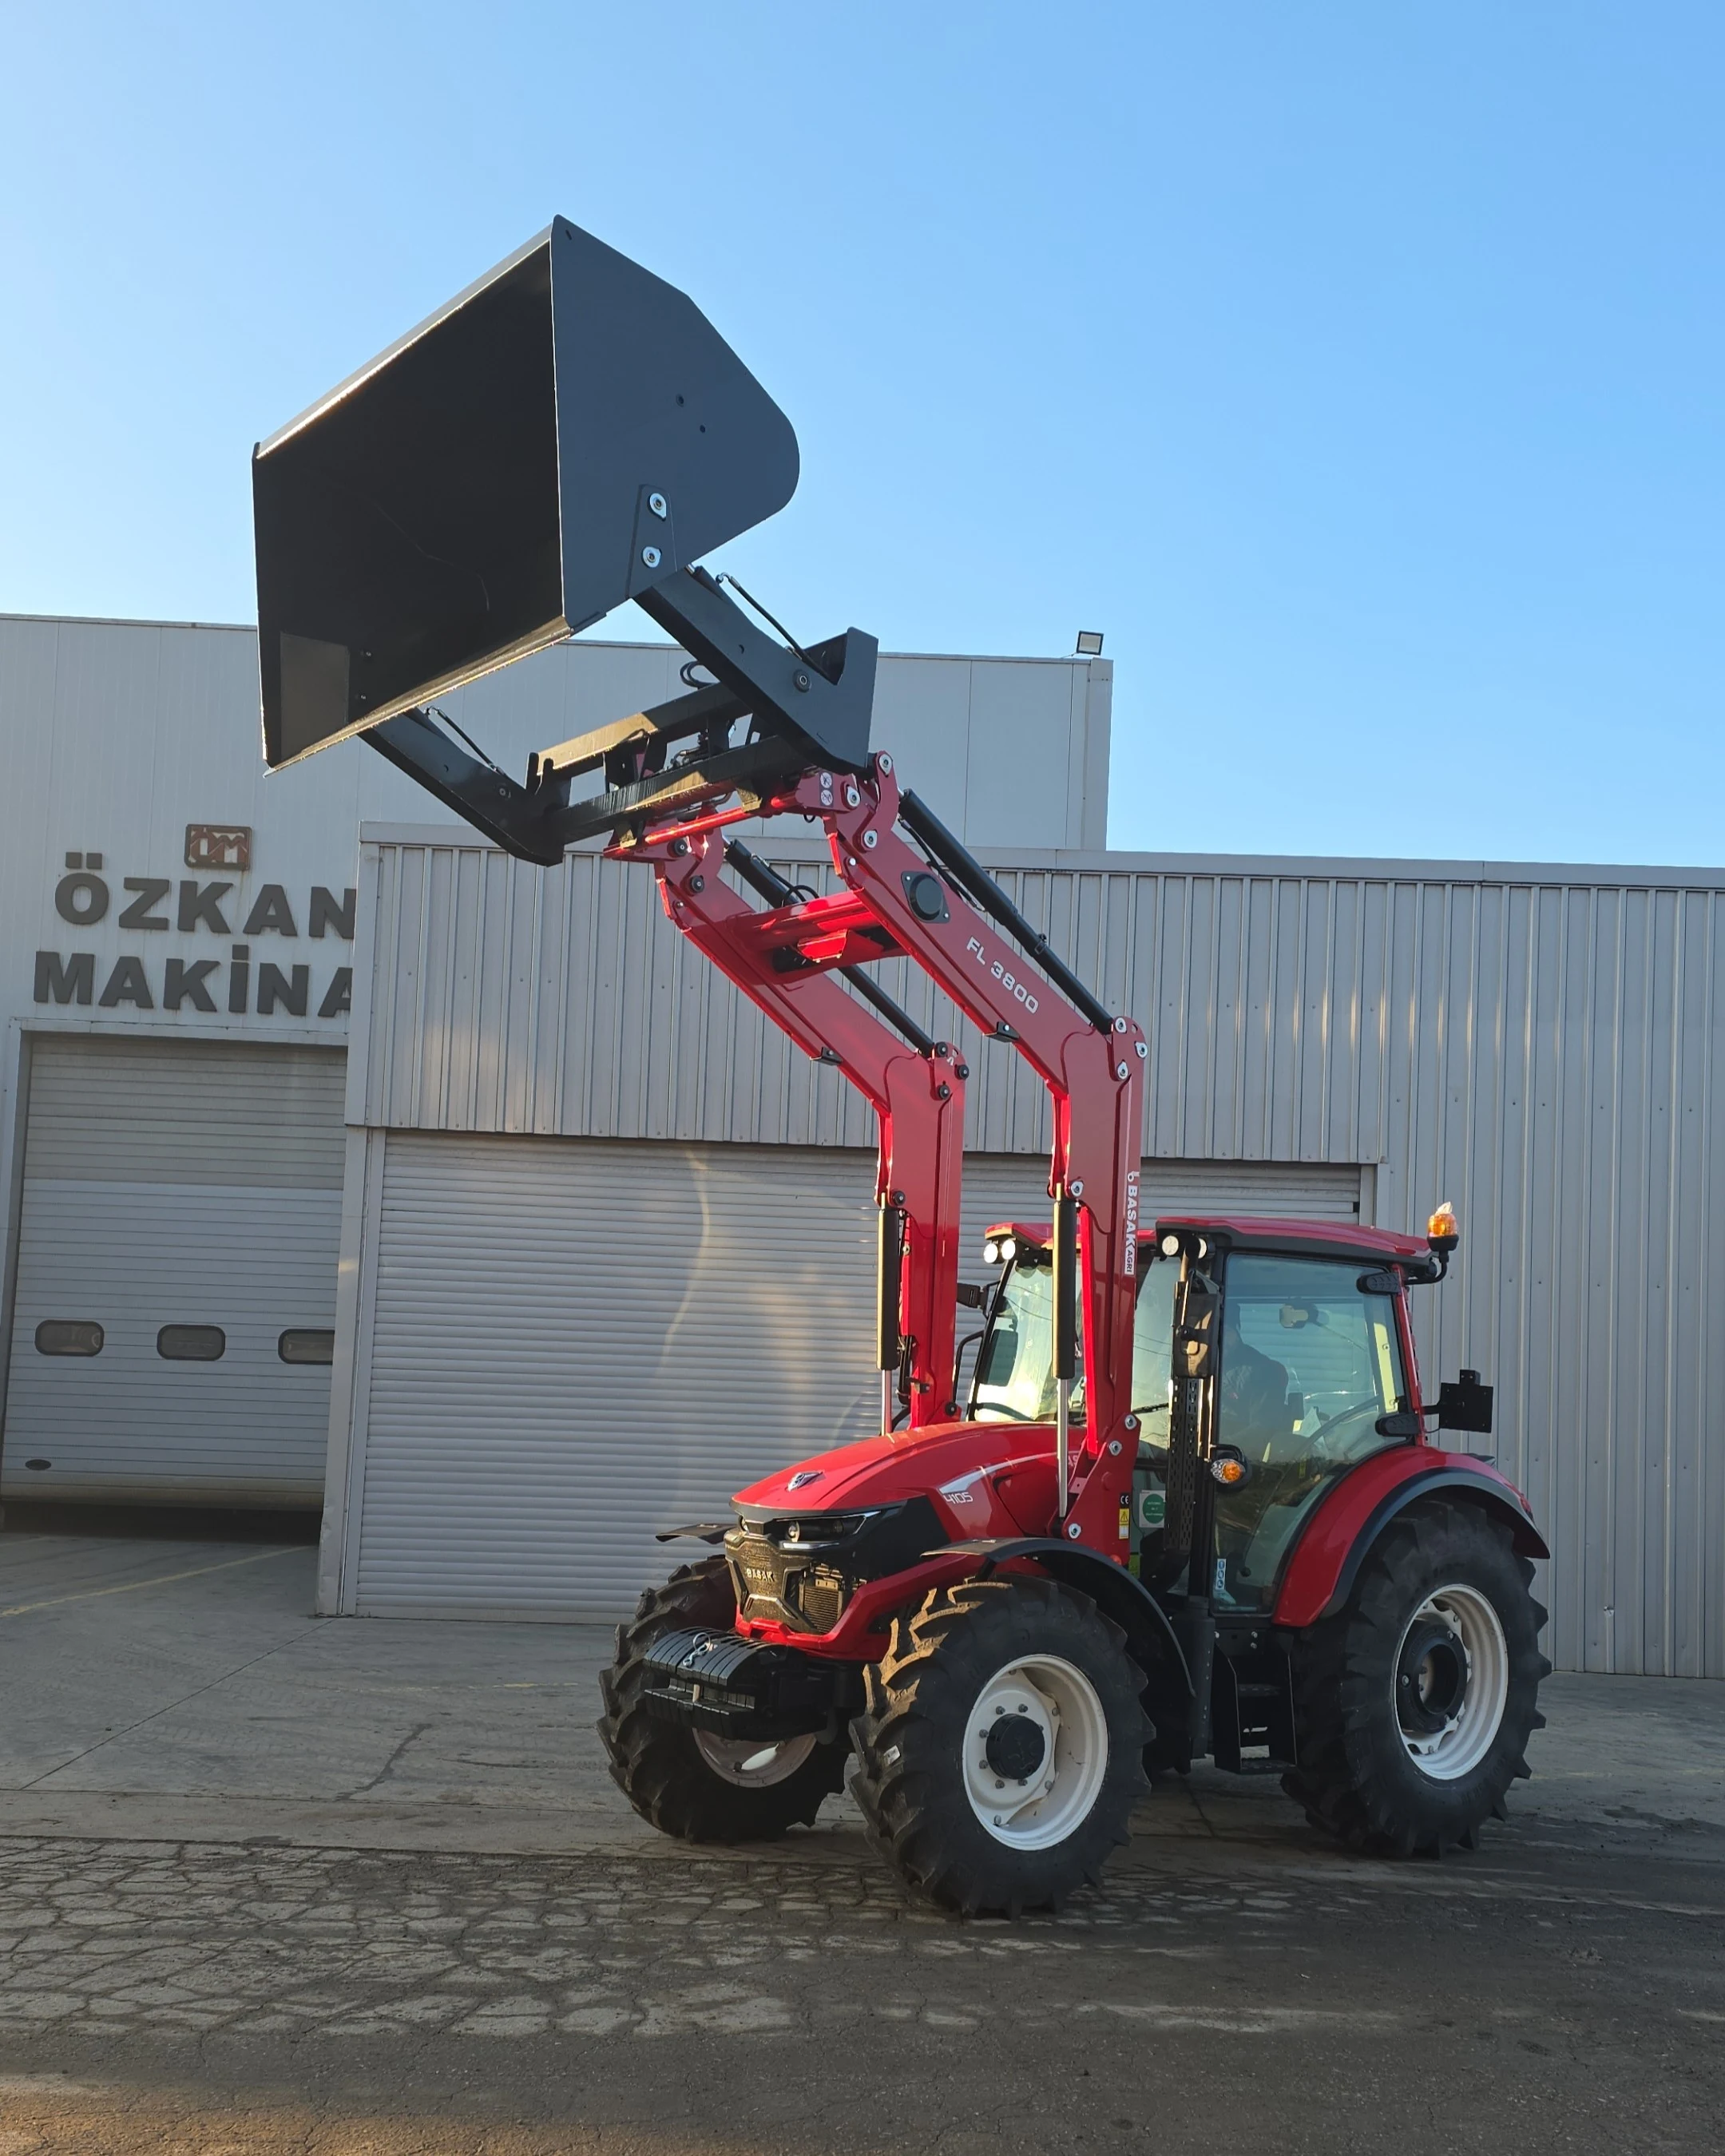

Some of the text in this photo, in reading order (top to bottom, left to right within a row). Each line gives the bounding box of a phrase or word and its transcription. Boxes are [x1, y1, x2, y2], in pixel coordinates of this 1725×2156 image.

[55, 852, 357, 939] ÖZKAN
[34, 945, 352, 1017] MAKİNA
[966, 937, 1039, 1014] FL 3800
[1127, 1185, 1137, 1248] BASAK
